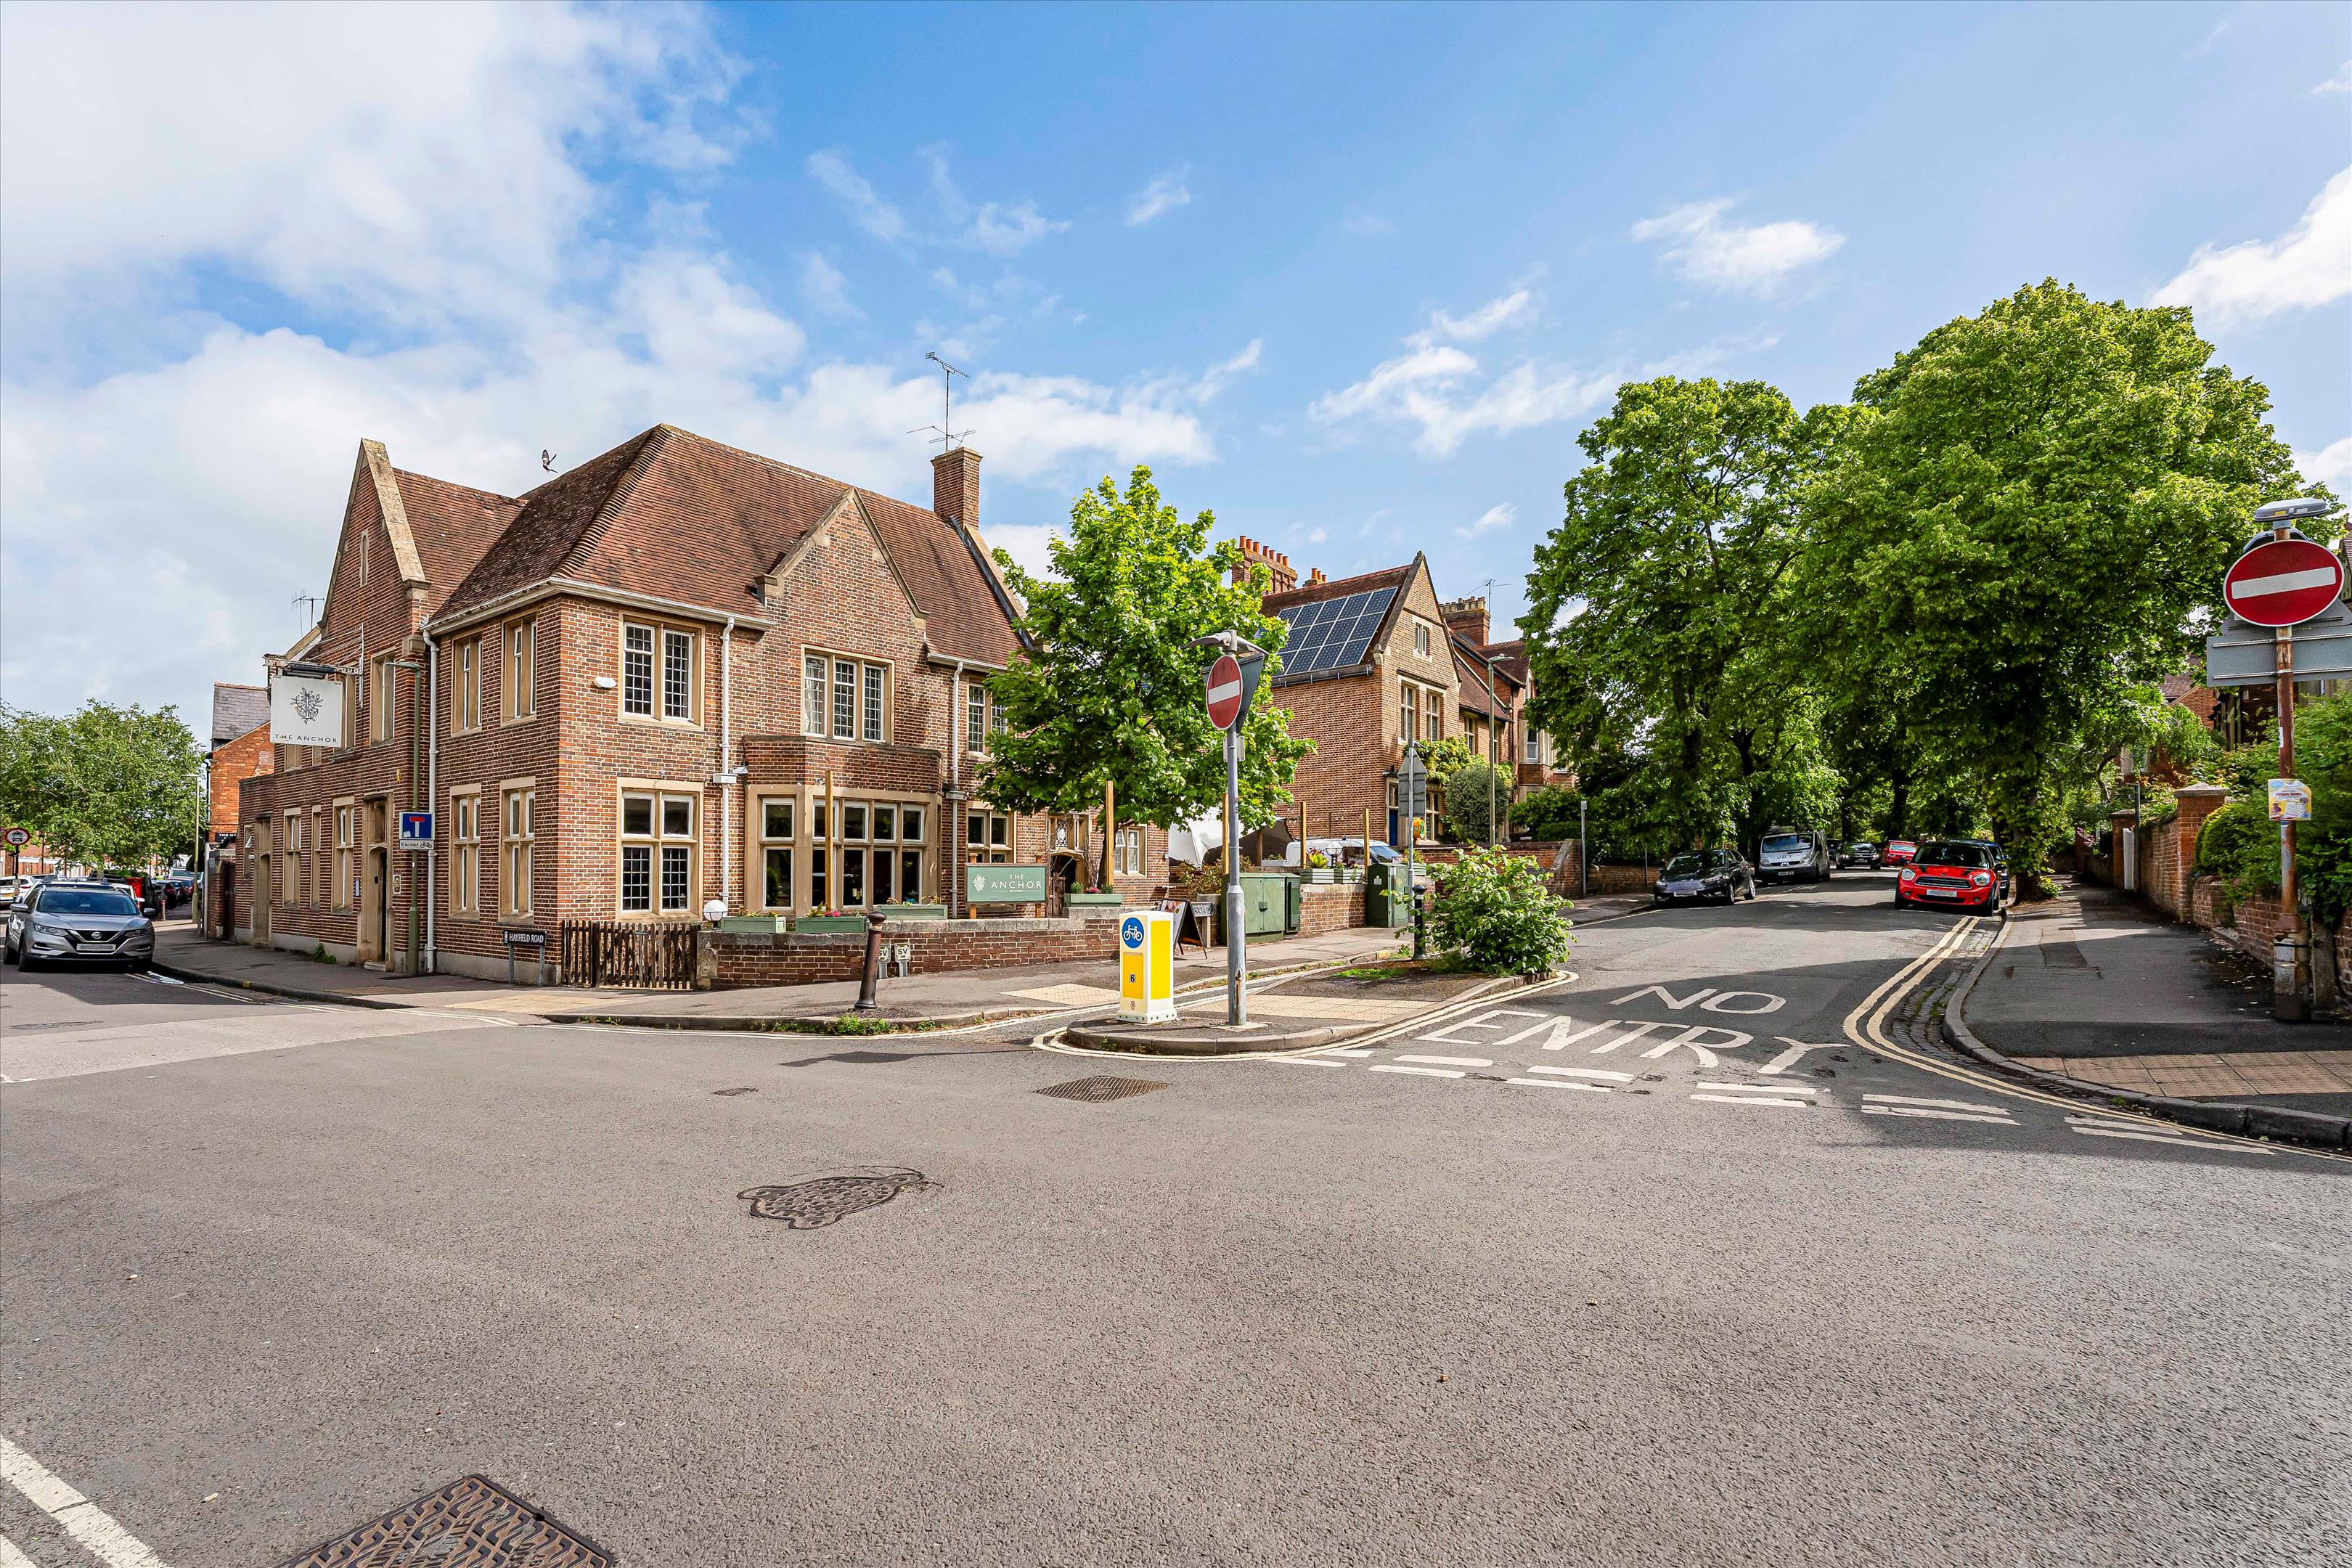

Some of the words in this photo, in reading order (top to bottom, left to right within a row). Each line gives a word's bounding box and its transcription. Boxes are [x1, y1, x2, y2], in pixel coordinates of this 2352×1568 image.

[509, 933, 530, 942] HAYFIELD
[531, 934, 544, 943] ROAD
[1608, 986, 1787, 1014] NO
[1413, 1010, 1850, 1074] ENTRY
